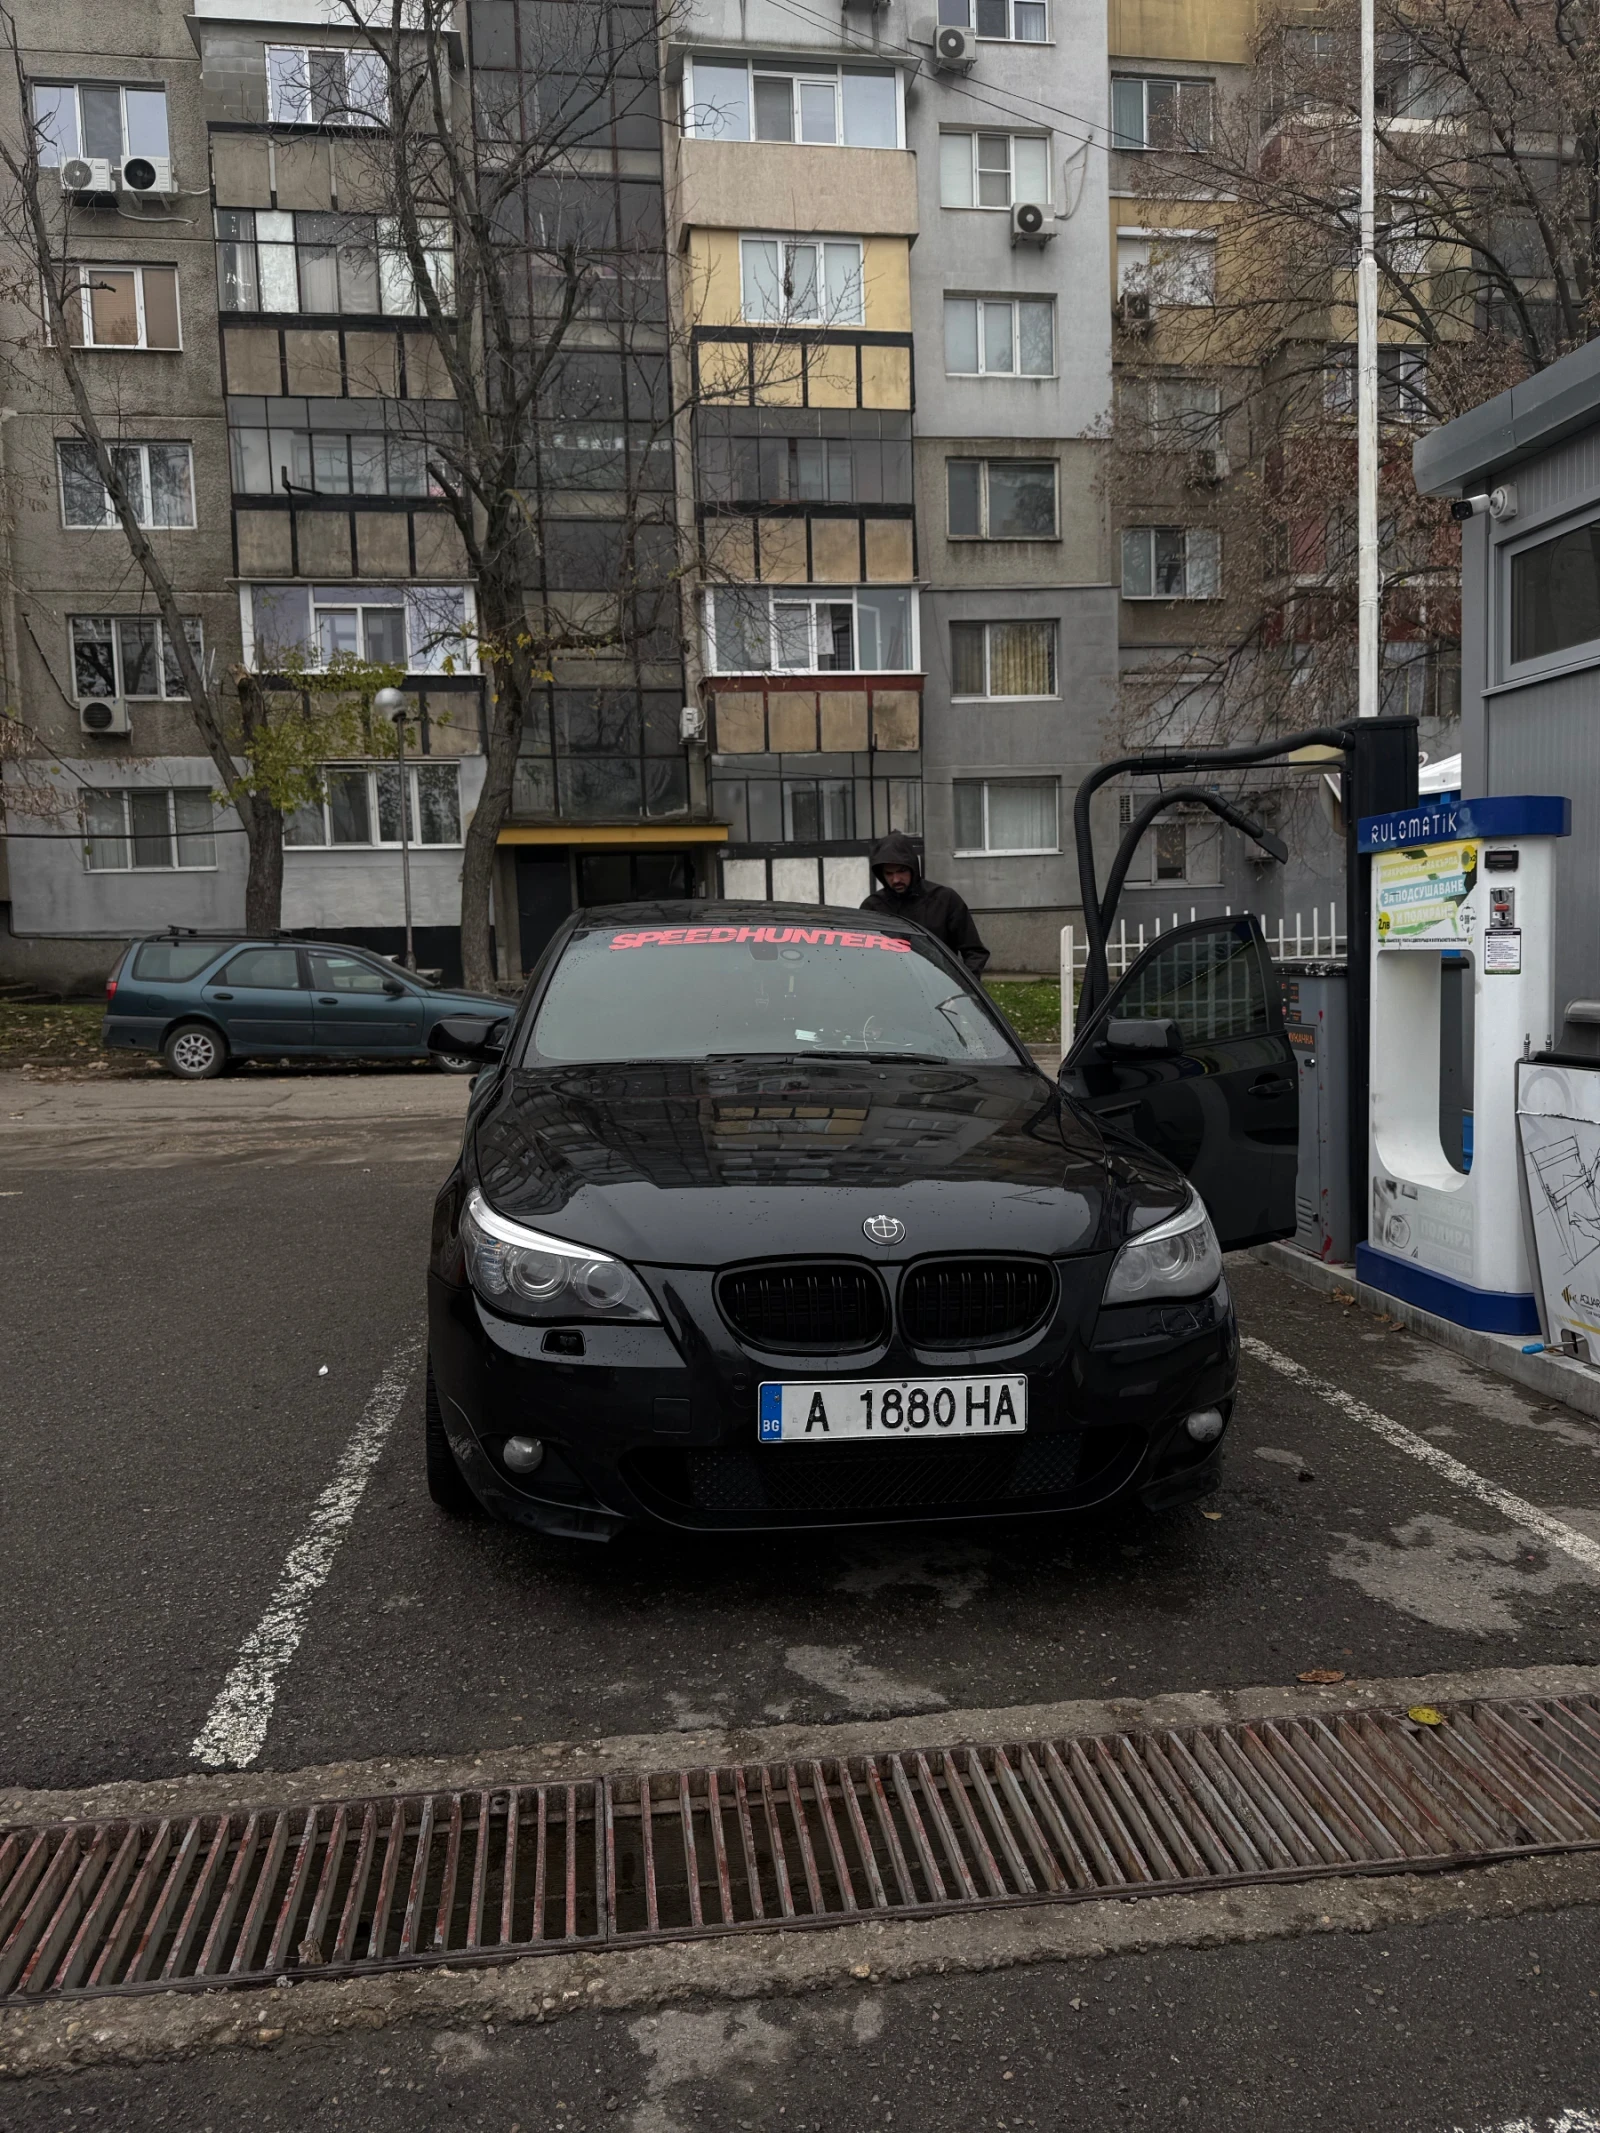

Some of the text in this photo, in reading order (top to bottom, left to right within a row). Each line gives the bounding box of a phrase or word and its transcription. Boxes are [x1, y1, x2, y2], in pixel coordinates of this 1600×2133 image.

[1395, 879, 1463, 902] ПОДСУШАВАНЕ
[609, 927, 911, 953] SPEEDHUNTERS
[804, 1391, 830, 1432] A
[763, 1420, 780, 1432] BG
